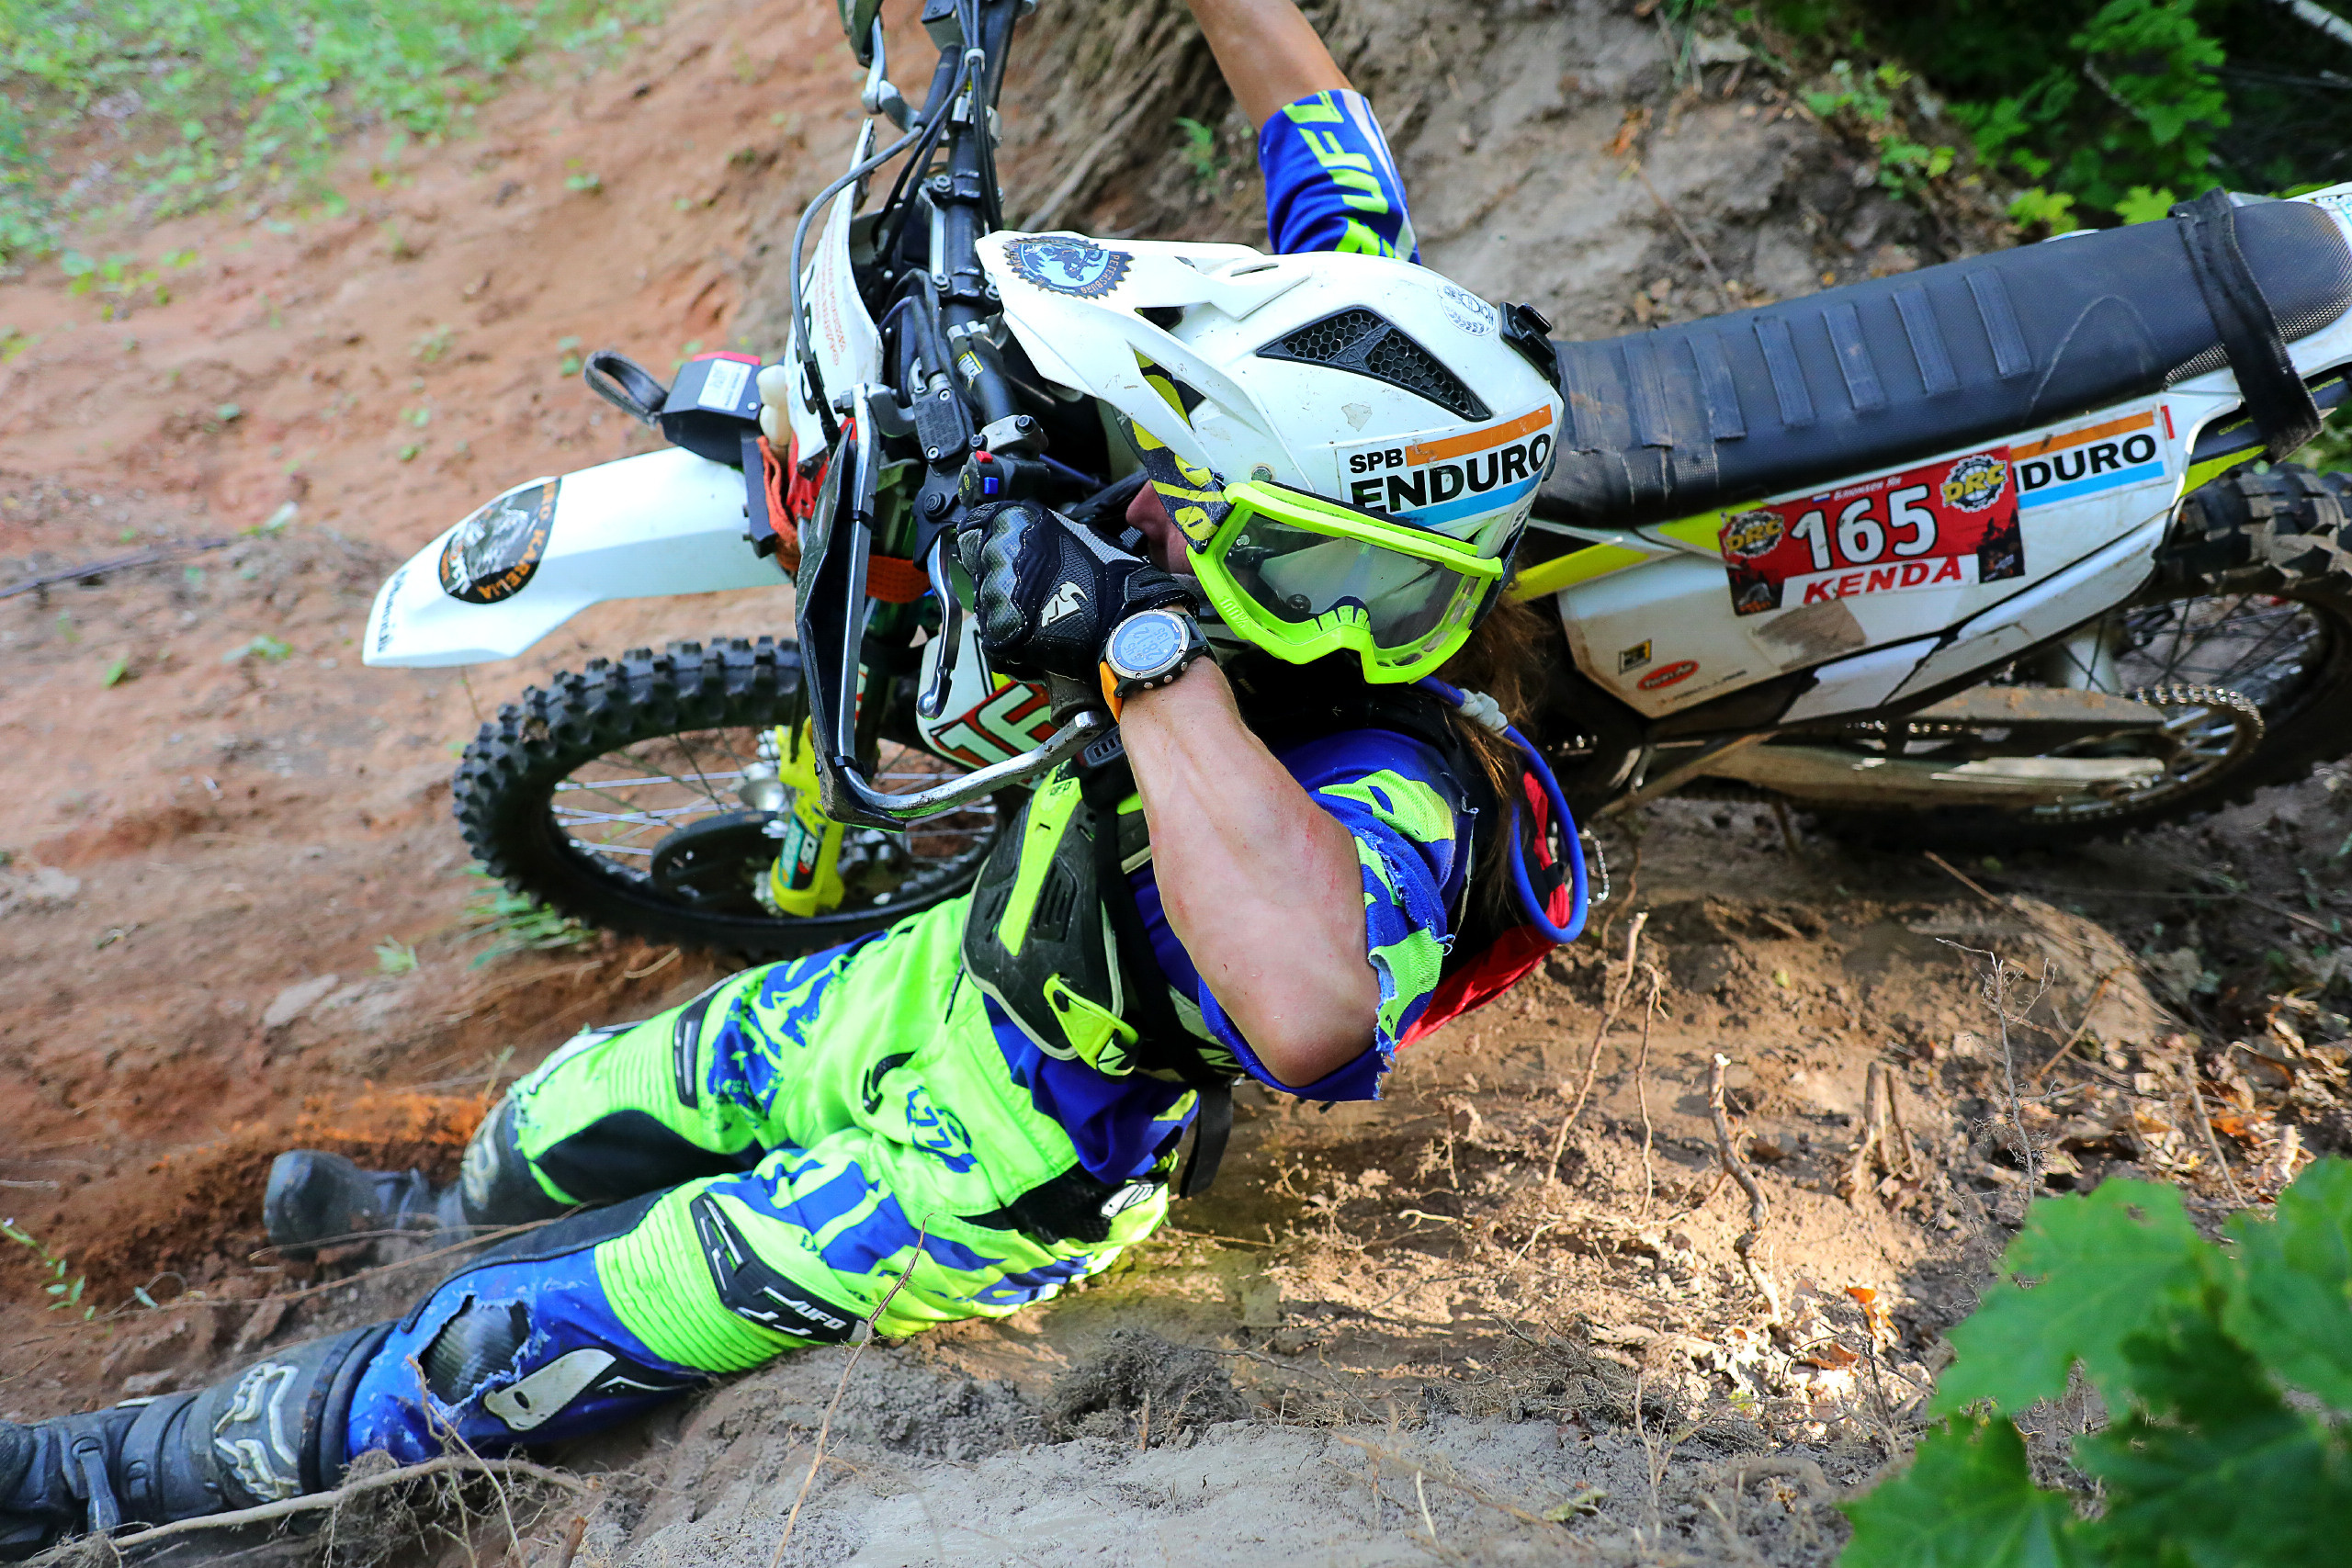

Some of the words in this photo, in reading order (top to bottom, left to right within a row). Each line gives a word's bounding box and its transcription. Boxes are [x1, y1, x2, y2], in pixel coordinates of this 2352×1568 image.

[1080, 254, 1121, 294] PETERSBURG
[1349, 447, 1404, 475] SPB
[1350, 433, 1552, 513] ENDURO
[1943, 463, 2006, 504] DRC
[1725, 519, 1782, 552] DRC
[1791, 484, 1938, 570] 165
[476, 529, 546, 600] KARELIA
[1803, 555, 1962, 604] KENDA
[1219, 595, 1251, 628] 100%
[795, 1302, 847, 1331] UFO
